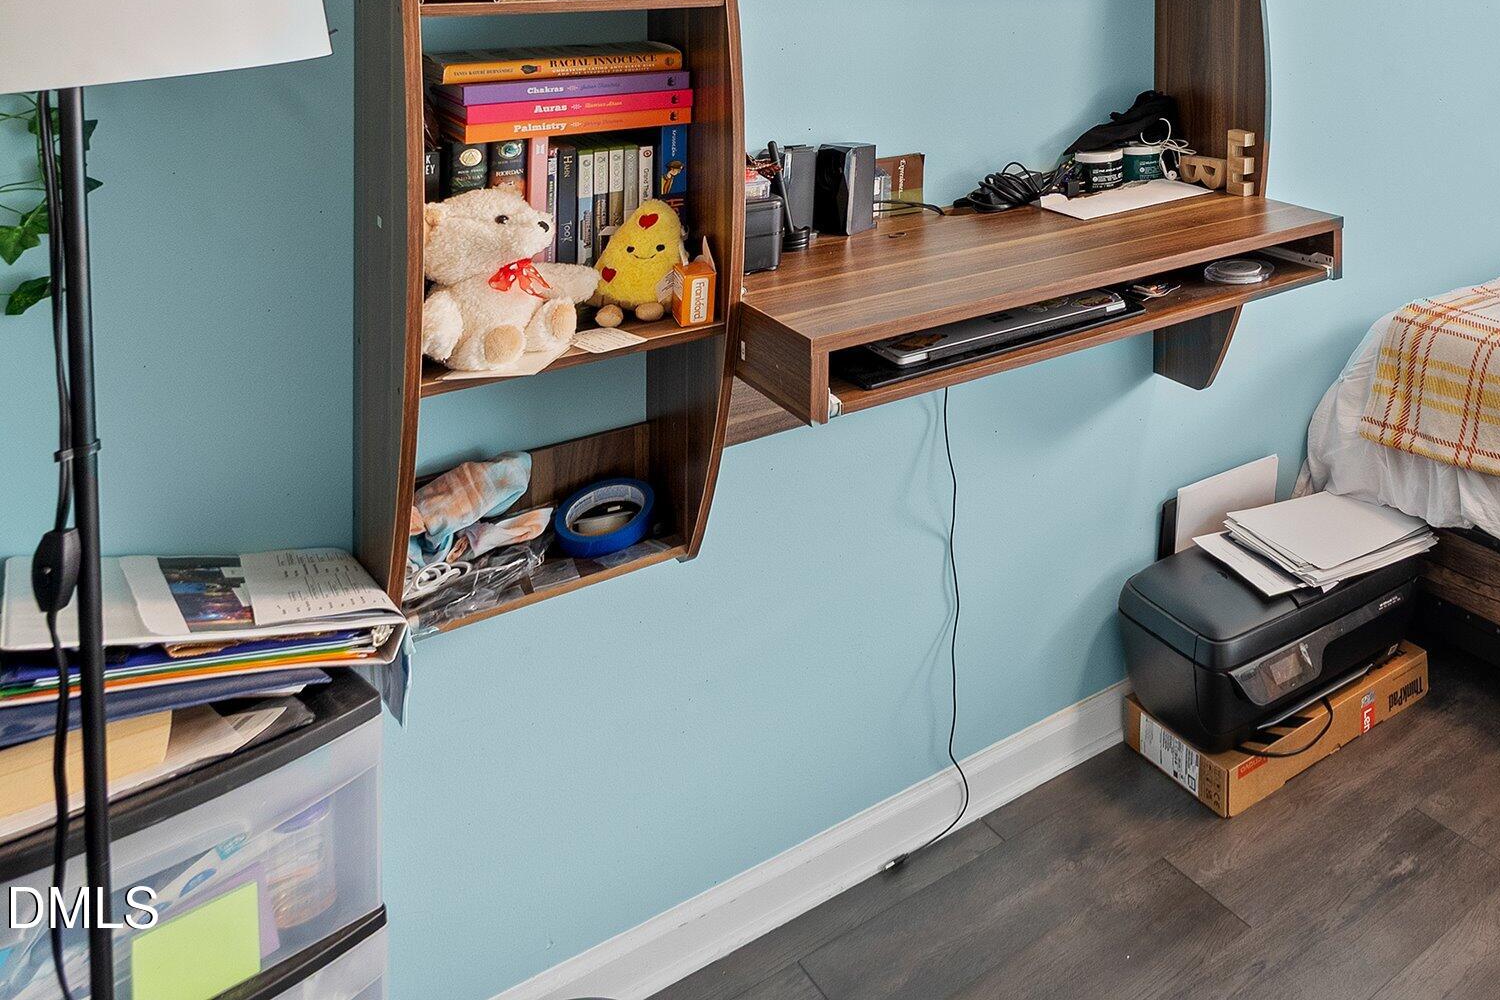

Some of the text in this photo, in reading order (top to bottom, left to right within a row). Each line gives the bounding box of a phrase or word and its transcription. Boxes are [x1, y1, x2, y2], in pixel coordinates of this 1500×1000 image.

[549, 54, 658, 68] RACIAL INNOCENCE
[527, 86, 564, 95] Chakras
[533, 104, 568, 114] Auras
[513, 121, 567, 133] Palmistry
[495, 168, 524, 177] RIORDAN
[1388, 676, 1424, 712] ThinkPad
